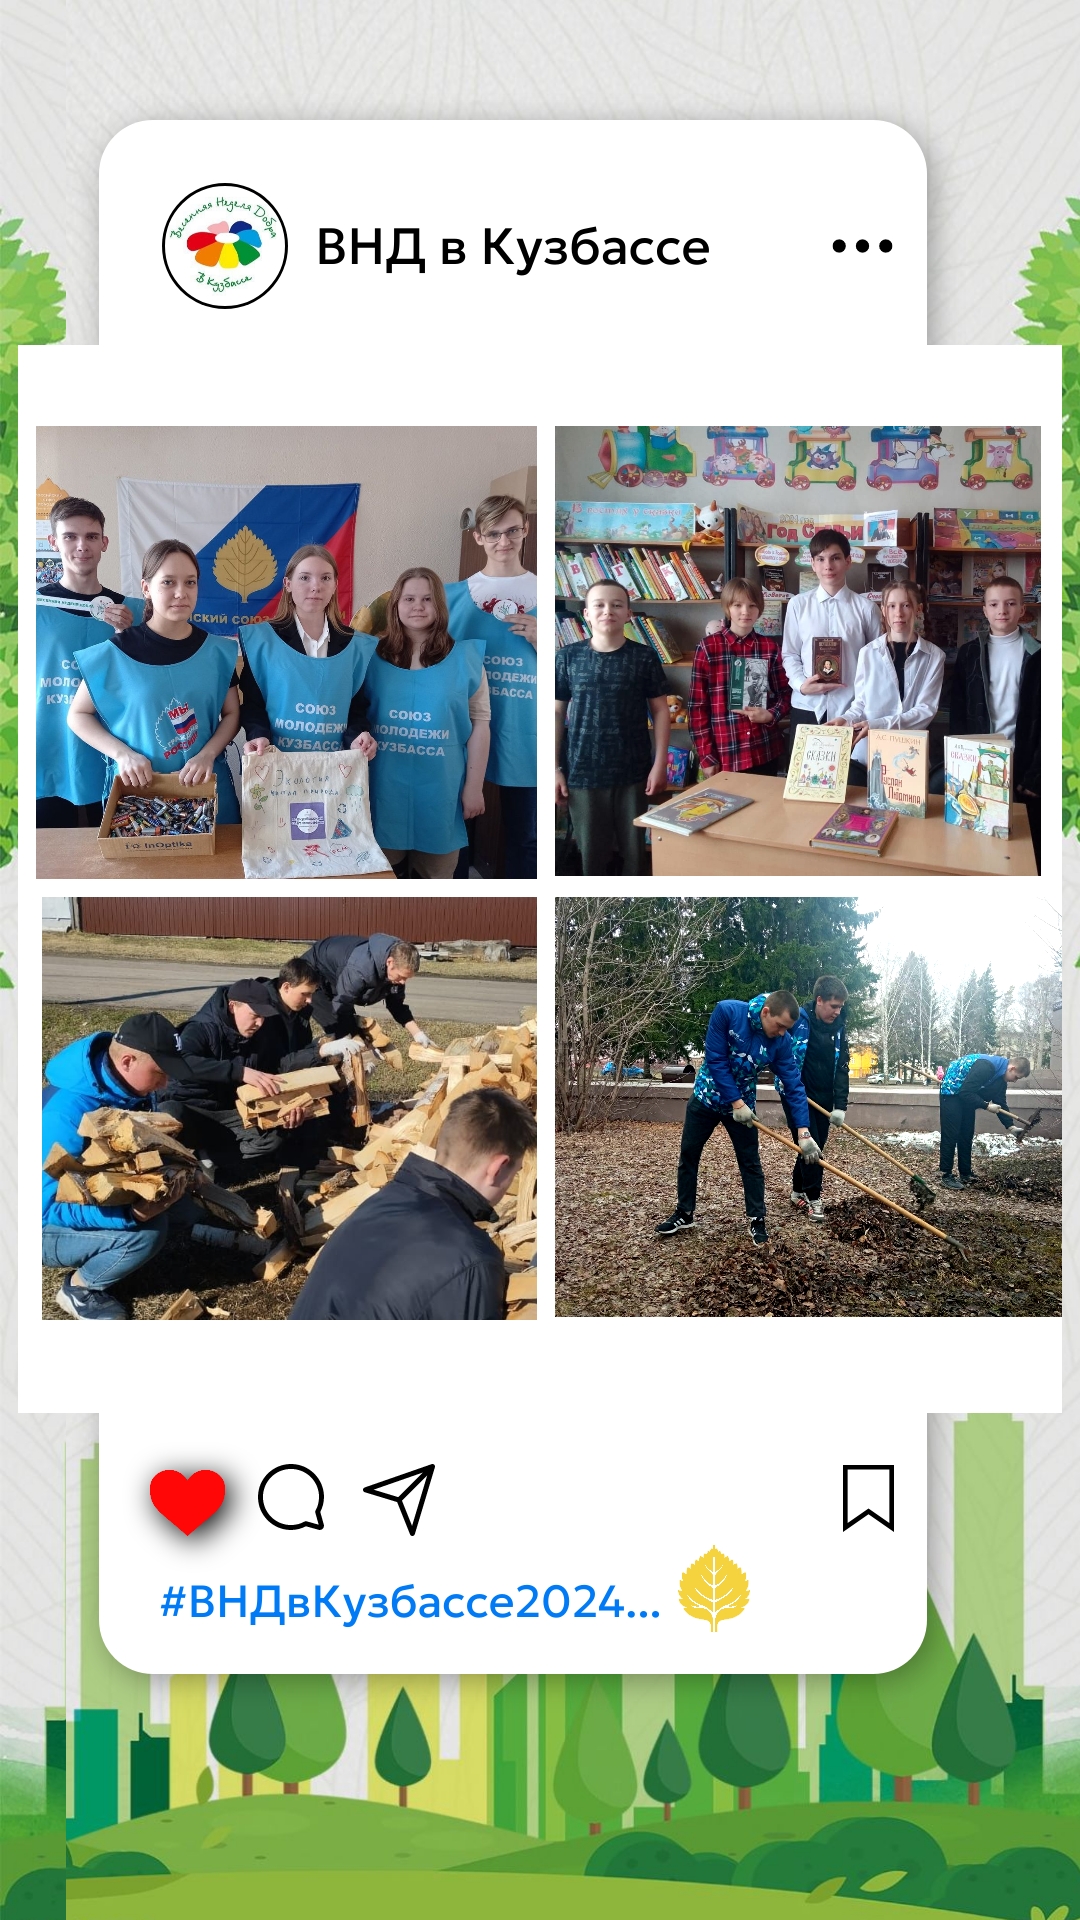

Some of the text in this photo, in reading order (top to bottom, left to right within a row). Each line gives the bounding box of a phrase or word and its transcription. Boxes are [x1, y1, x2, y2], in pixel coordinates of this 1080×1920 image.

[767, 523, 799, 543] Год
[295, 702, 336, 716] СОЮЗ
[388, 709, 432, 722] СОЮЗ
[889, 735, 921, 746] ПУШКИН
